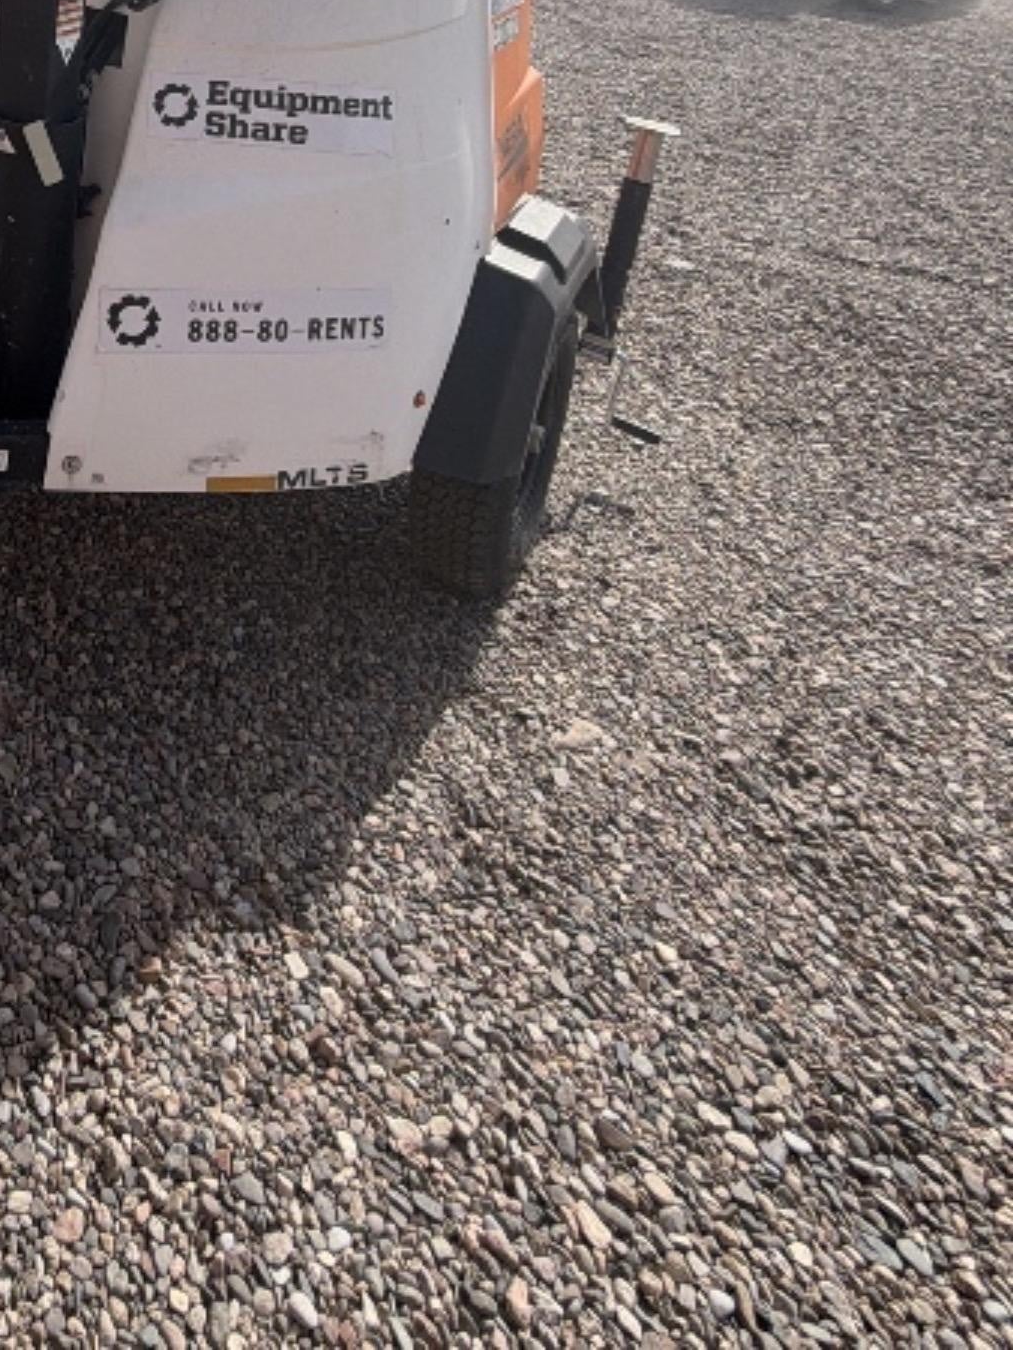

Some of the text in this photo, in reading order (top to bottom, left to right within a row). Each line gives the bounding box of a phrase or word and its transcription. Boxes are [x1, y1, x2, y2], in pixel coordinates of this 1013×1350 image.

[205, 81, 394, 120] Equipment
[204, 111, 309, 145] Share
[188, 300, 263, 313] CALL NOW
[188, 315, 385, 343] 888-80-RENTS
[276, 462, 369, 491] MLTS
